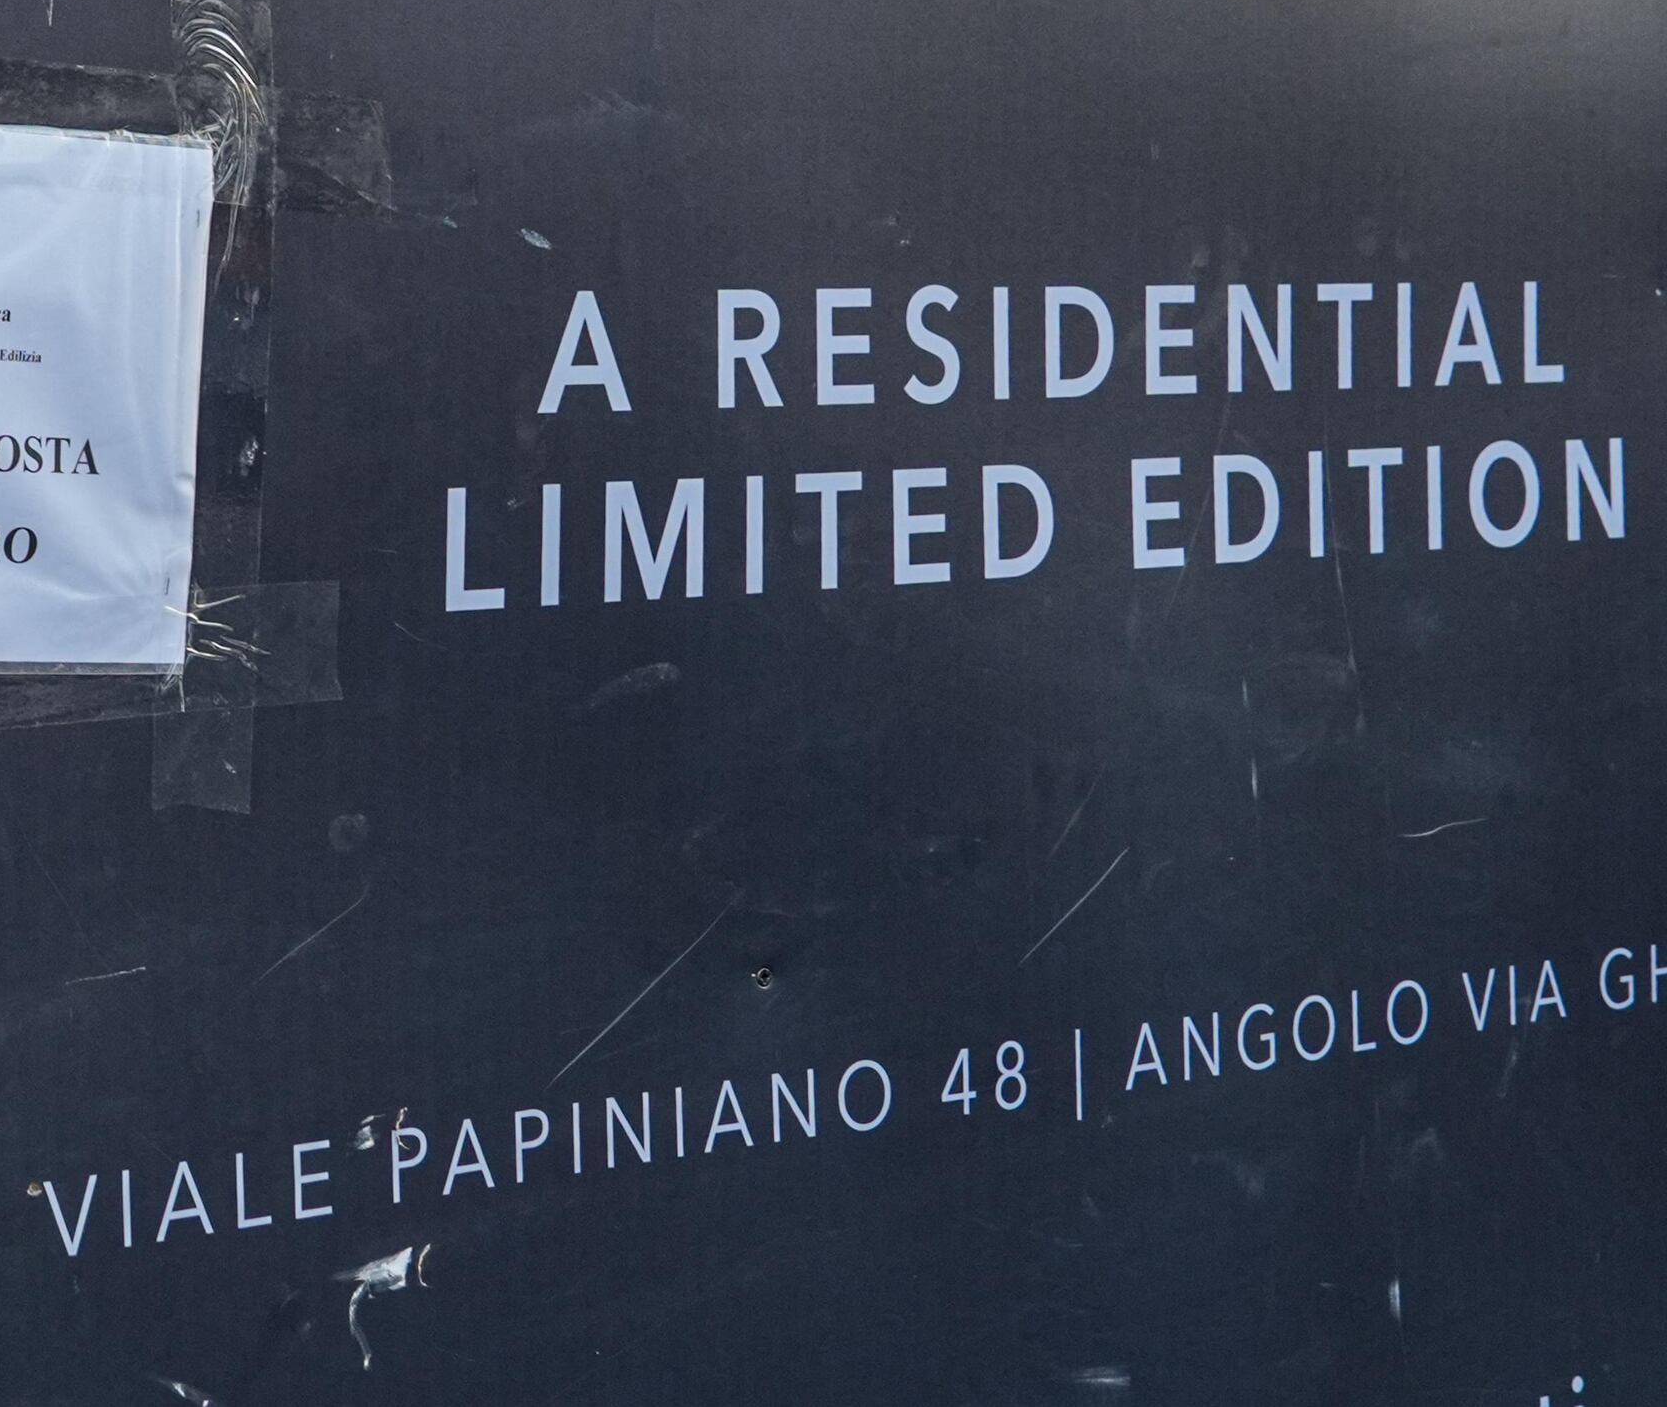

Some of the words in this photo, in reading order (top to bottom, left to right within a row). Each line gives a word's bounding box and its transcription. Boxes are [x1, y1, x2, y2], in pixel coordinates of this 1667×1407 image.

[0, 349, 42, 364] Edilizia
[537, 289, 632, 414] A
[717, 279, 1566, 409] RESIDENTIAL
[445, 462, 1056, 612] LIMITED
[1130, 435, 1629, 571] EDITION
[42, 1138, 335, 1259] VIALE
[389, 1059, 893, 1206] PAPINIANO
[940, 1040, 1030, 1118] 48
[1125, 979, 1431, 1093] ANGOLO
[1461, 956, 1568, 1033] VIA
